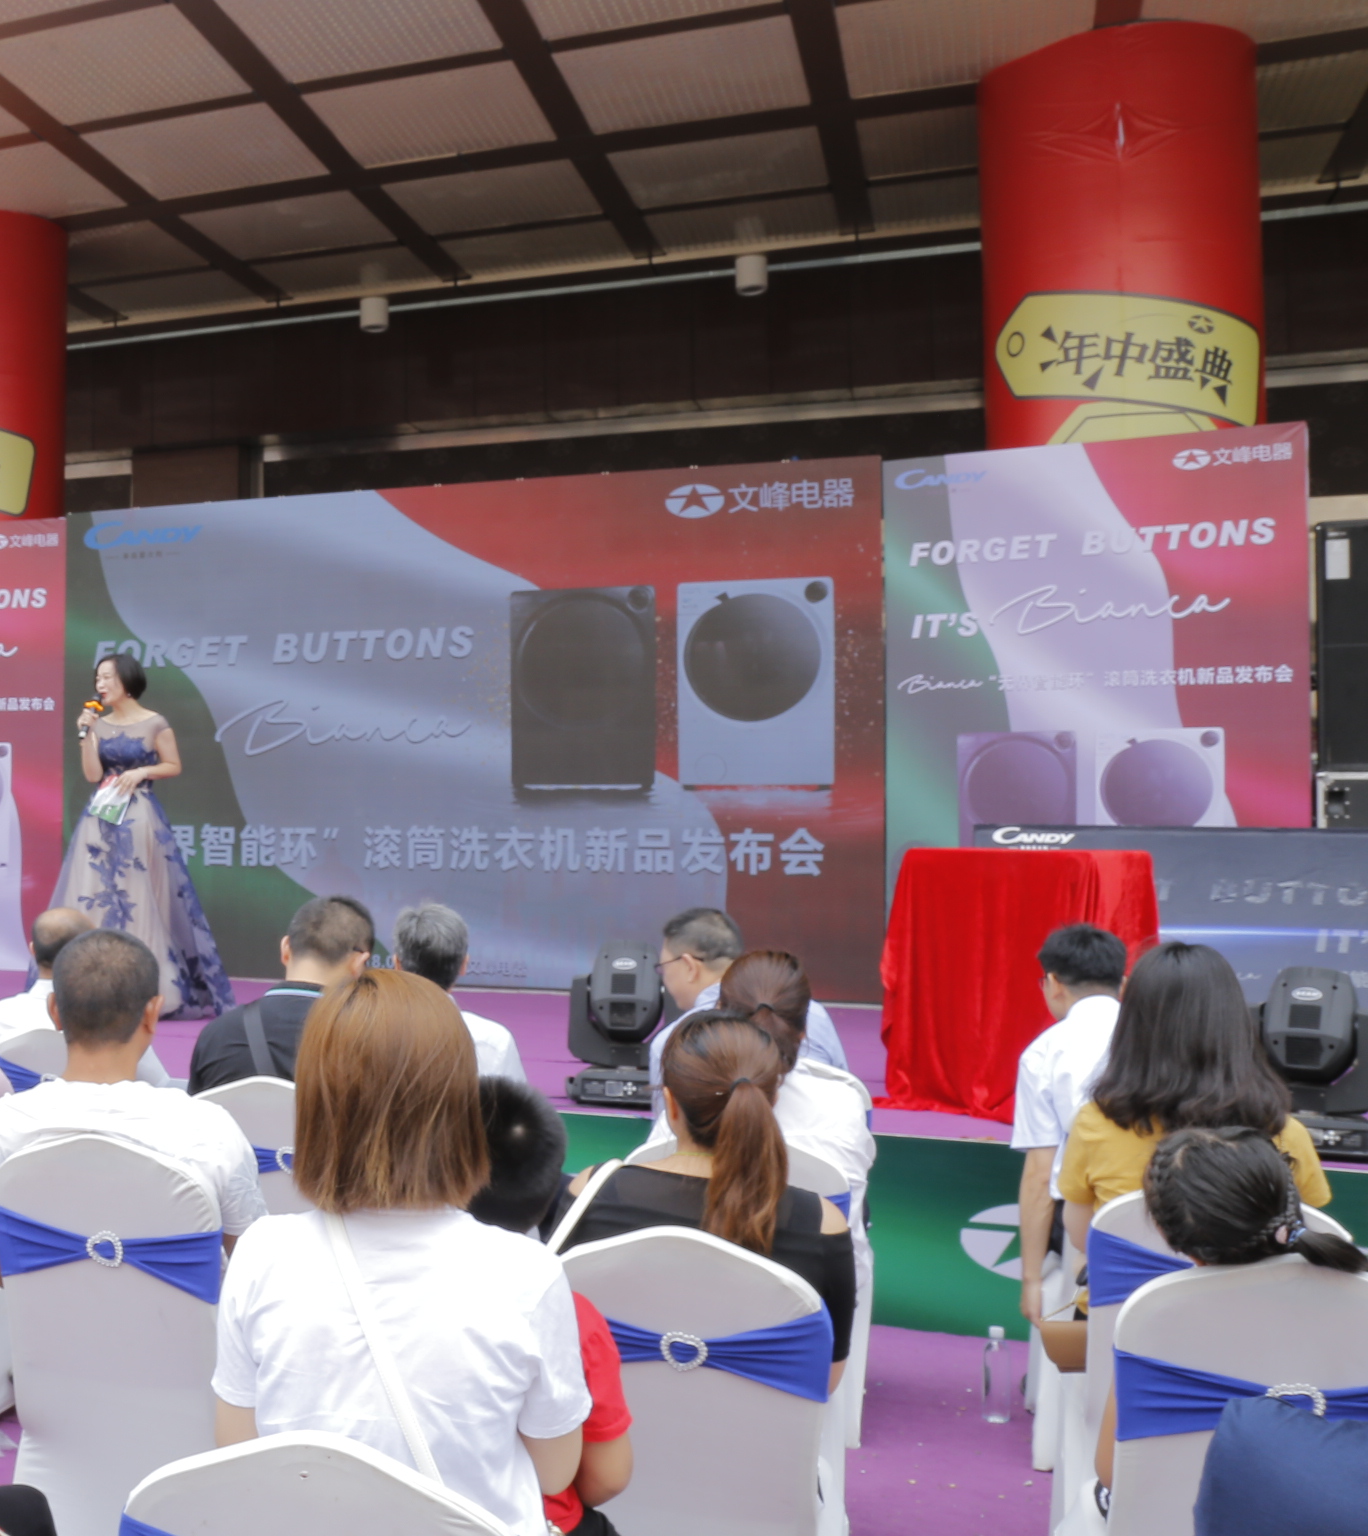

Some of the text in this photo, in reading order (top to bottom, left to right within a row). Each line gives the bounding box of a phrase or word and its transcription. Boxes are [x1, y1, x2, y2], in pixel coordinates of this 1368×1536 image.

[1055, 330, 1234, 385] 年中盛典
[1212, 443, 1293, 467] 文峰电器
[728, 478, 854, 513] 文峰电器
[9, 533, 59, 548] 文峰电器
[909, 517, 1277, 567] FORGET BUTTONS
[911, 584, 1232, 639] IT'S Bianca
[272, 625, 475, 665] BUTTONS
[897, 673, 984, 695] Bianca
[1103, 664, 1294, 687] 滚筒洗衣机新品发布会
[214, 700, 474, 757] Bianca
[363, 824, 826, 876] 滚筒洗衣机新品发布会
